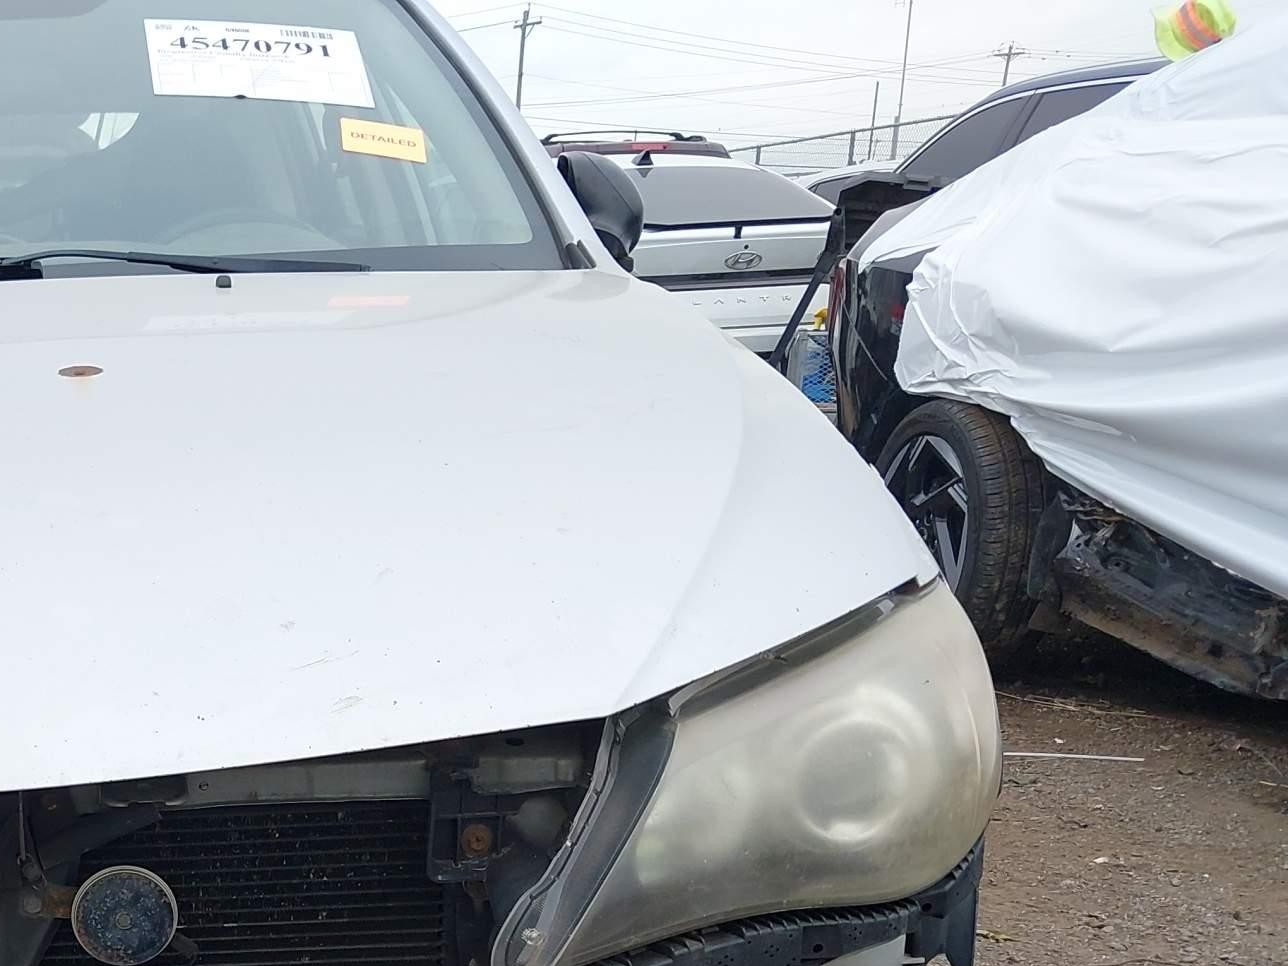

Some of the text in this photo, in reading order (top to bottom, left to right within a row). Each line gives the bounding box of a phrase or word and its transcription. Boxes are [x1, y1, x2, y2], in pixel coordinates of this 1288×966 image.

[170, 36, 331, 57] 45470791
[350, 131, 417, 148] DETAILED
[691, 294, 793, 307] LANTR
